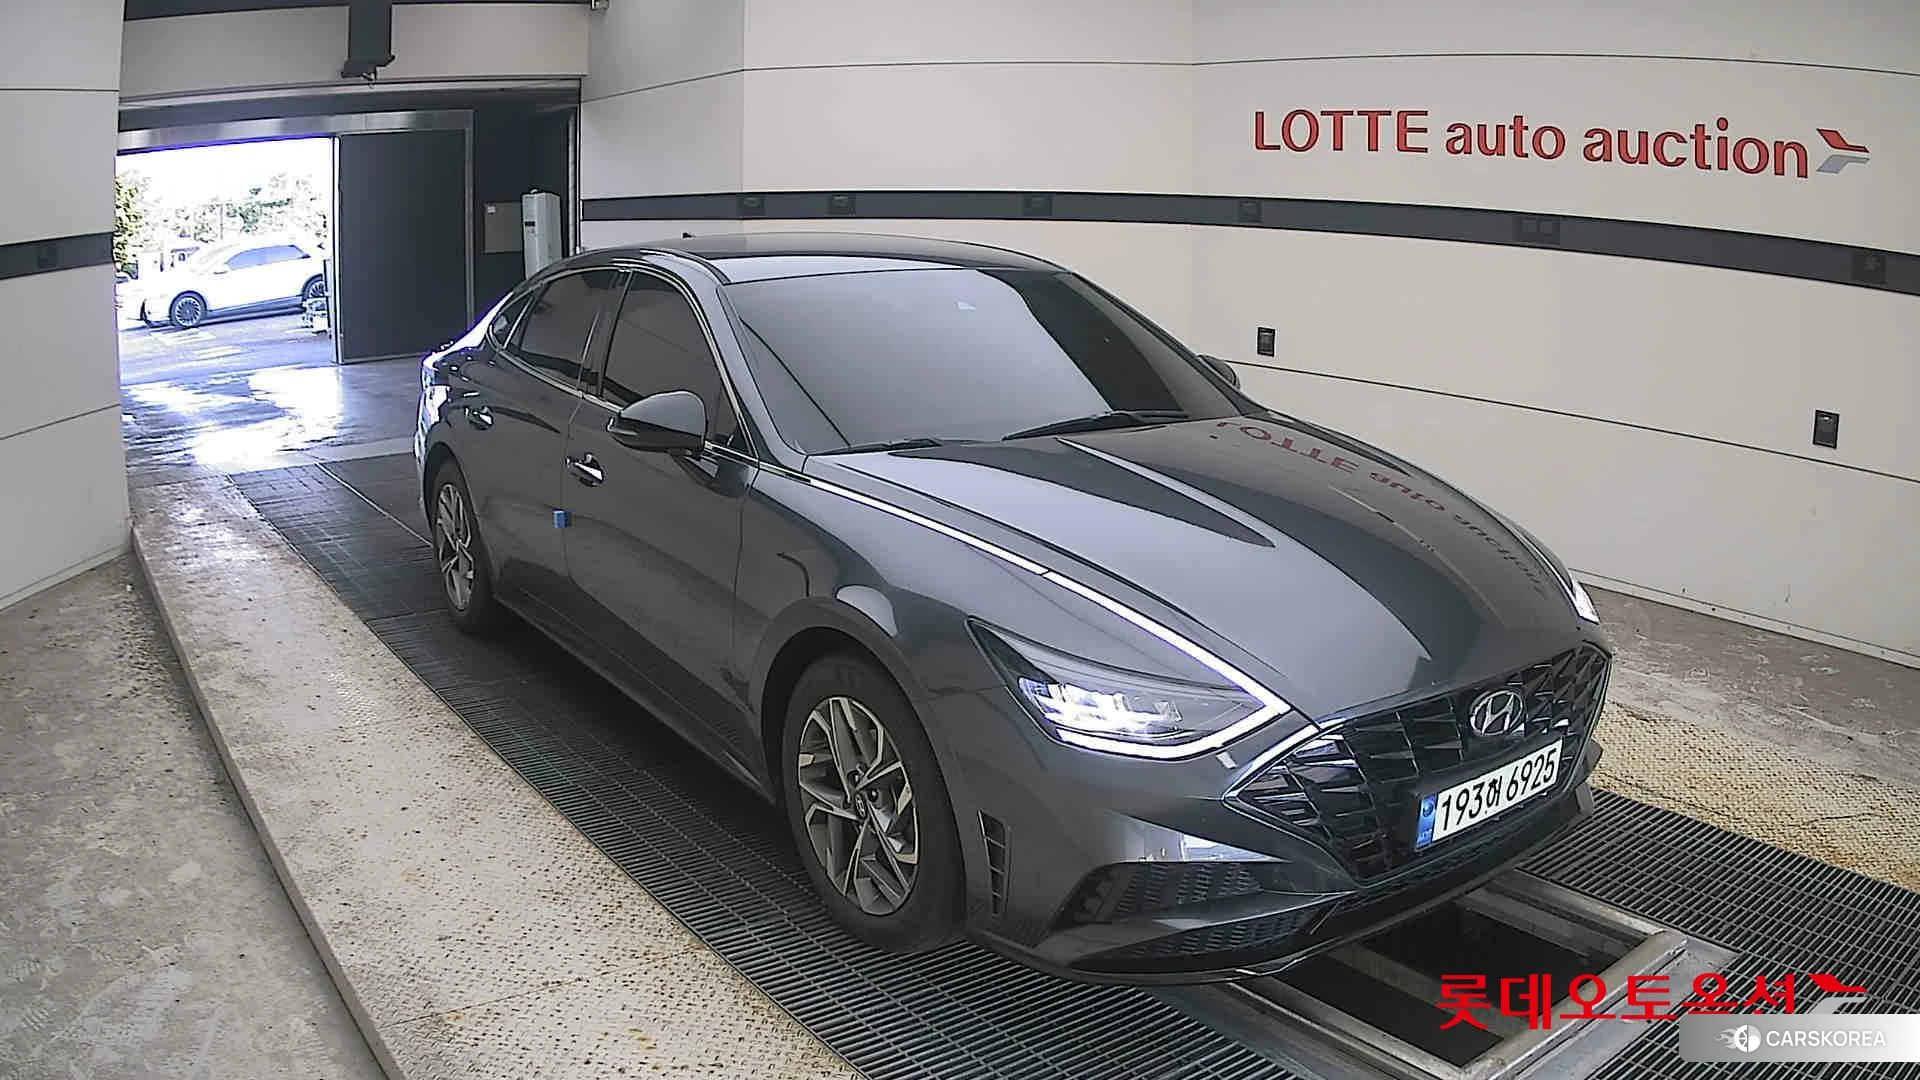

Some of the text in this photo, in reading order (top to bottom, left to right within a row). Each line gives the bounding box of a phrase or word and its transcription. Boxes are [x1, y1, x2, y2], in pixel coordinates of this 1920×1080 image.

[1254, 109, 1808, 179] LOTTE auto auction
[1506, 747, 1558, 801] 6925
